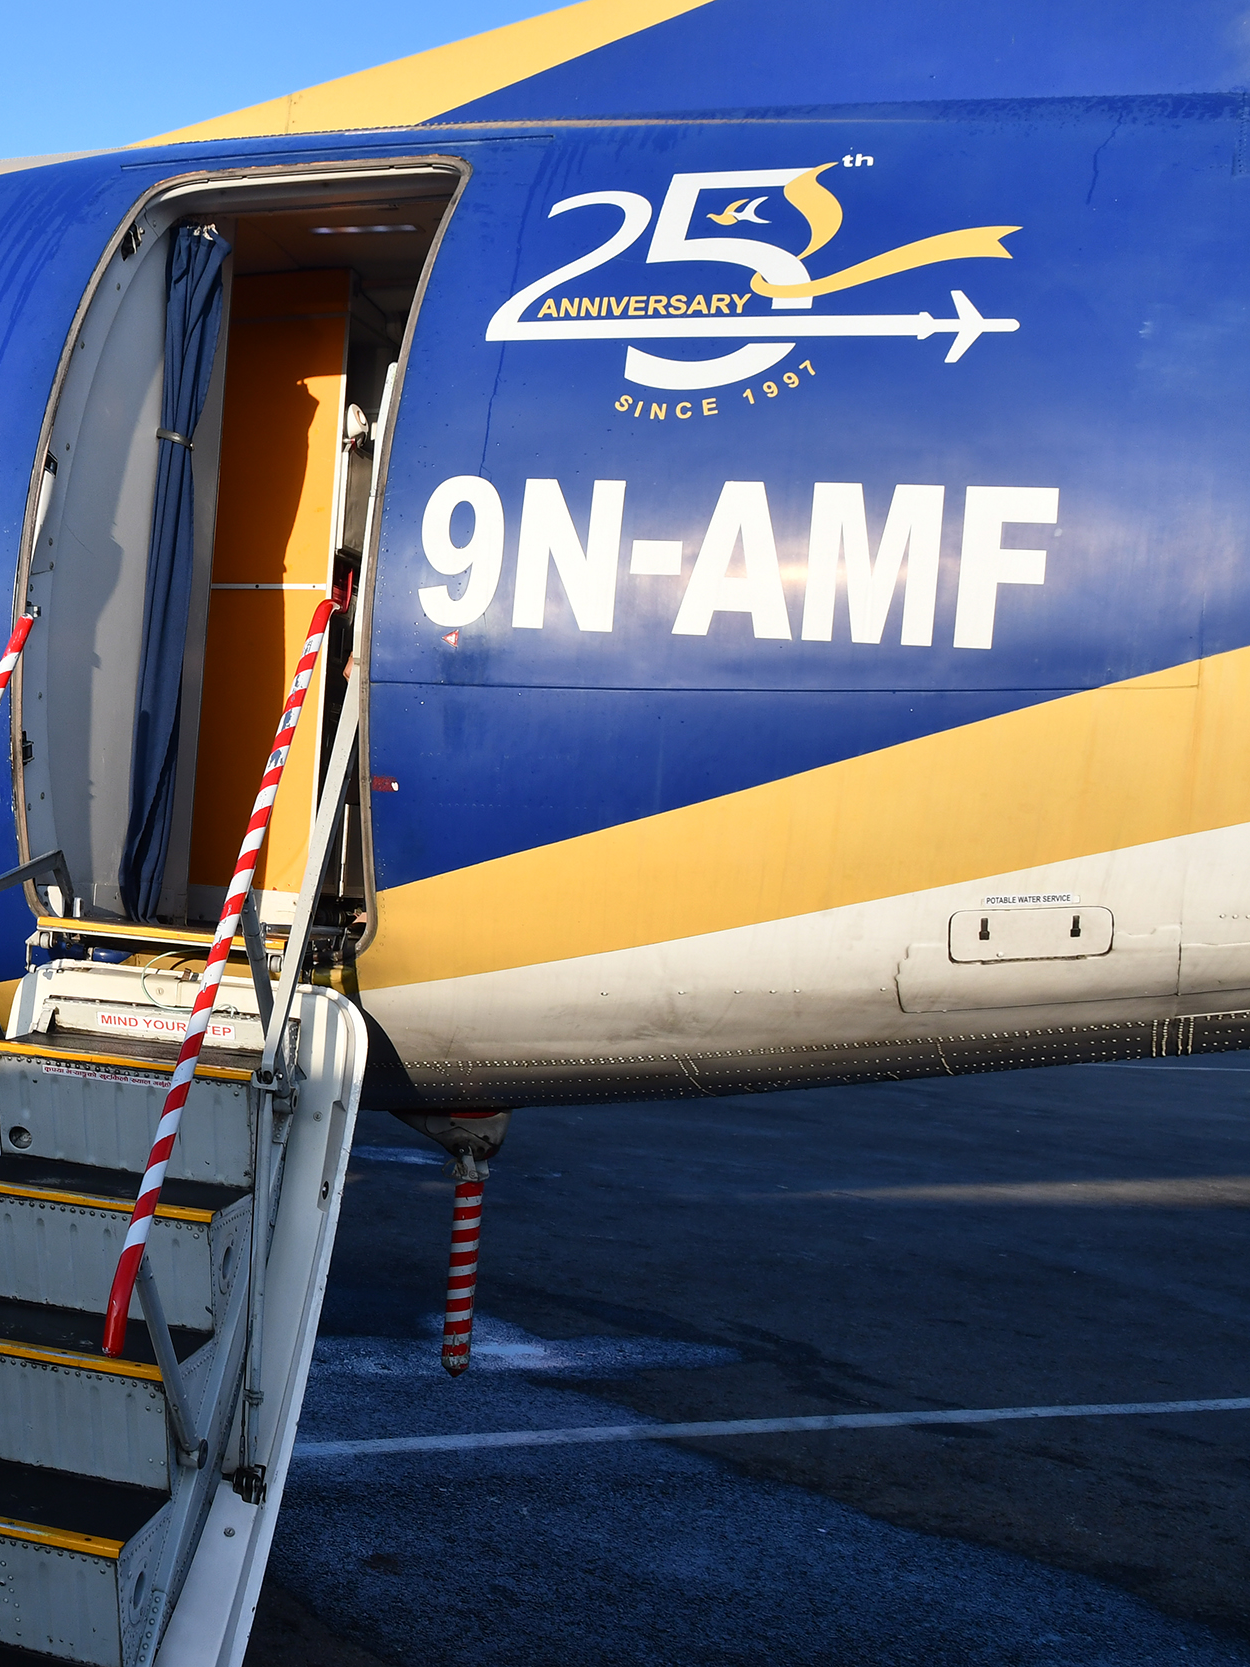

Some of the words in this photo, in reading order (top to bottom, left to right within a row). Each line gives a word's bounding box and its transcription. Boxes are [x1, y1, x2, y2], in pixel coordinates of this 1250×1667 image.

[537, 293, 752, 318] ANNIVERSARY
[614, 394, 720, 420] SINCE
[743, 359, 817, 405] 1997
[418, 475, 1060, 650] 9N-AMF
[986, 896, 1017, 904] POTABLE
[1018, 895, 1041, 903] WATER
[1042, 894, 1071, 902] SERVICE
[101, 1014, 139, 1028] MIND
[143, 1018, 187, 1033] YOUR
[205, 1025, 232, 1037] TEP
